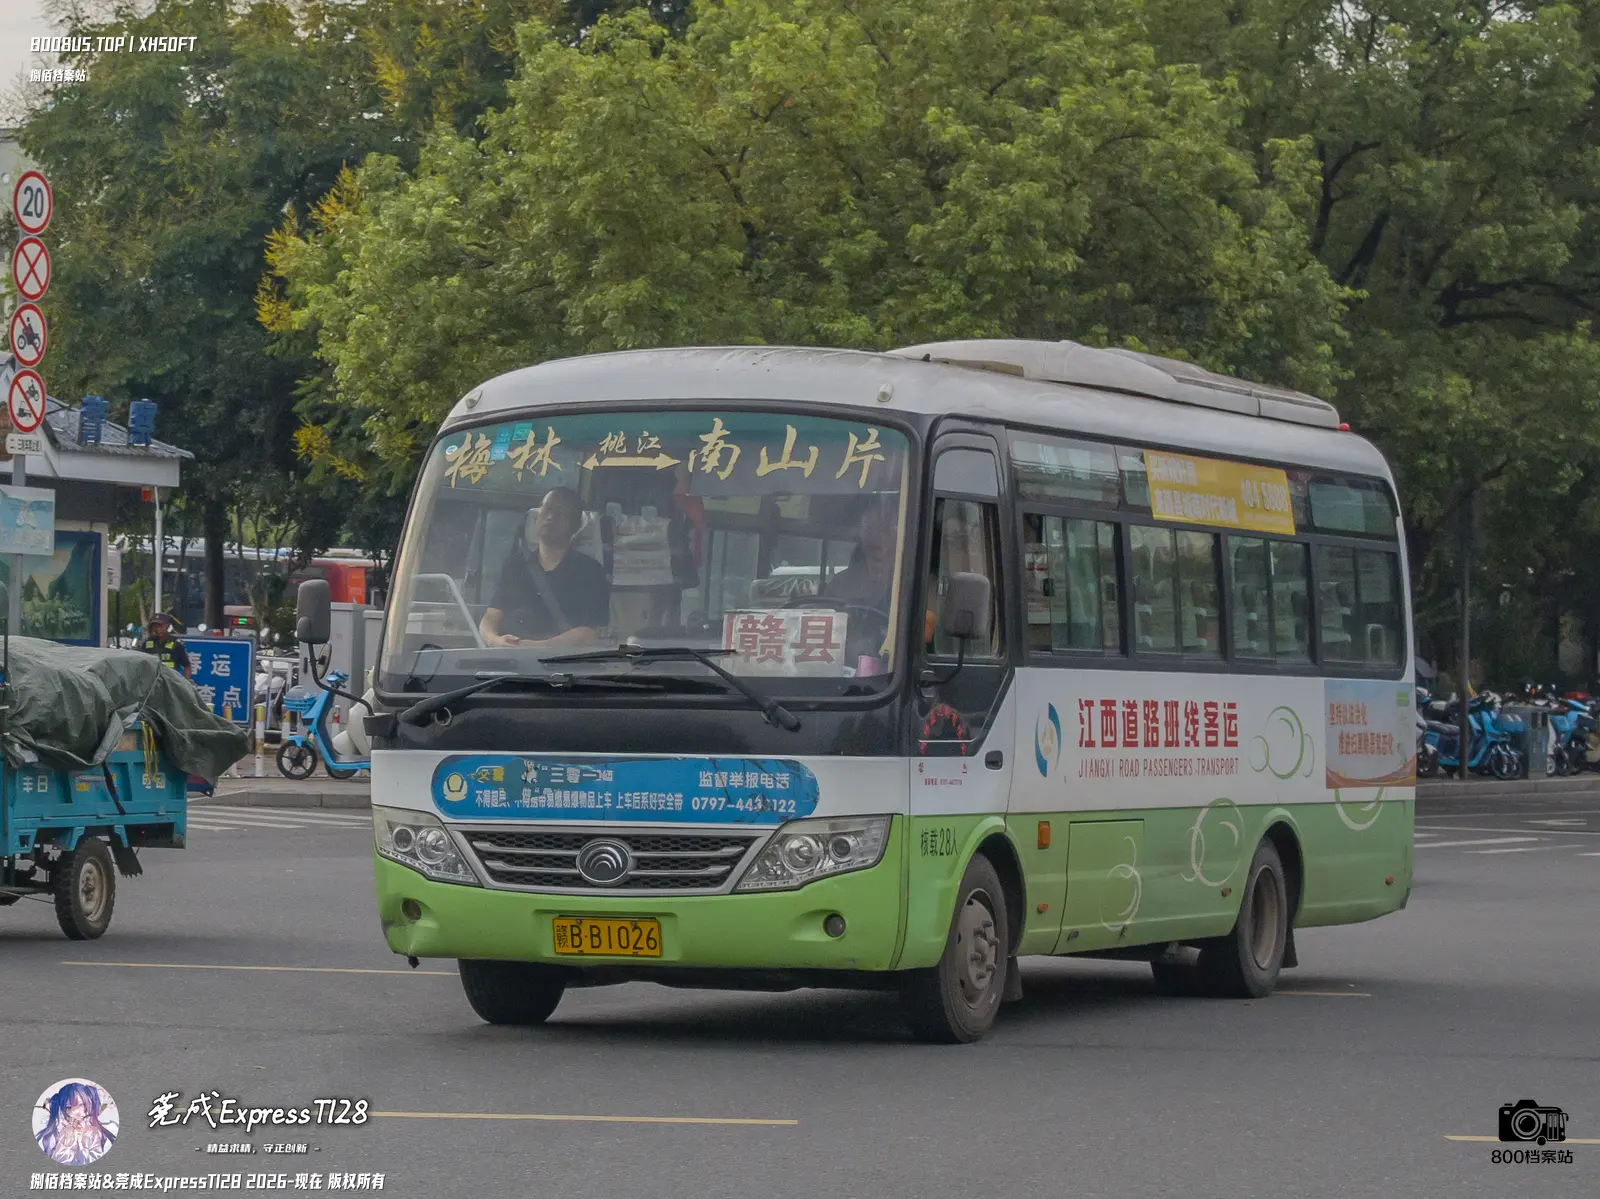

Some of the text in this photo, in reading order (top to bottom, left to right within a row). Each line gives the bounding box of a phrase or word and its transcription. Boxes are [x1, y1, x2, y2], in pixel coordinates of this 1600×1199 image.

[23, 185, 44, 218] 20
[444, 427, 563, 488] 梅林
[688, 417, 886, 488] 南山片
[599, 431, 663, 454] 桃江
[737, 614, 841, 664] 赣县
[1078, 698, 1239, 748] 江西道路班线客运
[698, 771, 790, 789] 监督举报电话
[1078, 757, 1239, 778] JIANGXI ROAD PASSENGERS TRANSPORT
[616, 792, 683, 811] 上车后系好安全带
[691, 796, 796, 813] 0797-443122
[920, 826, 960, 857] 核载28人
